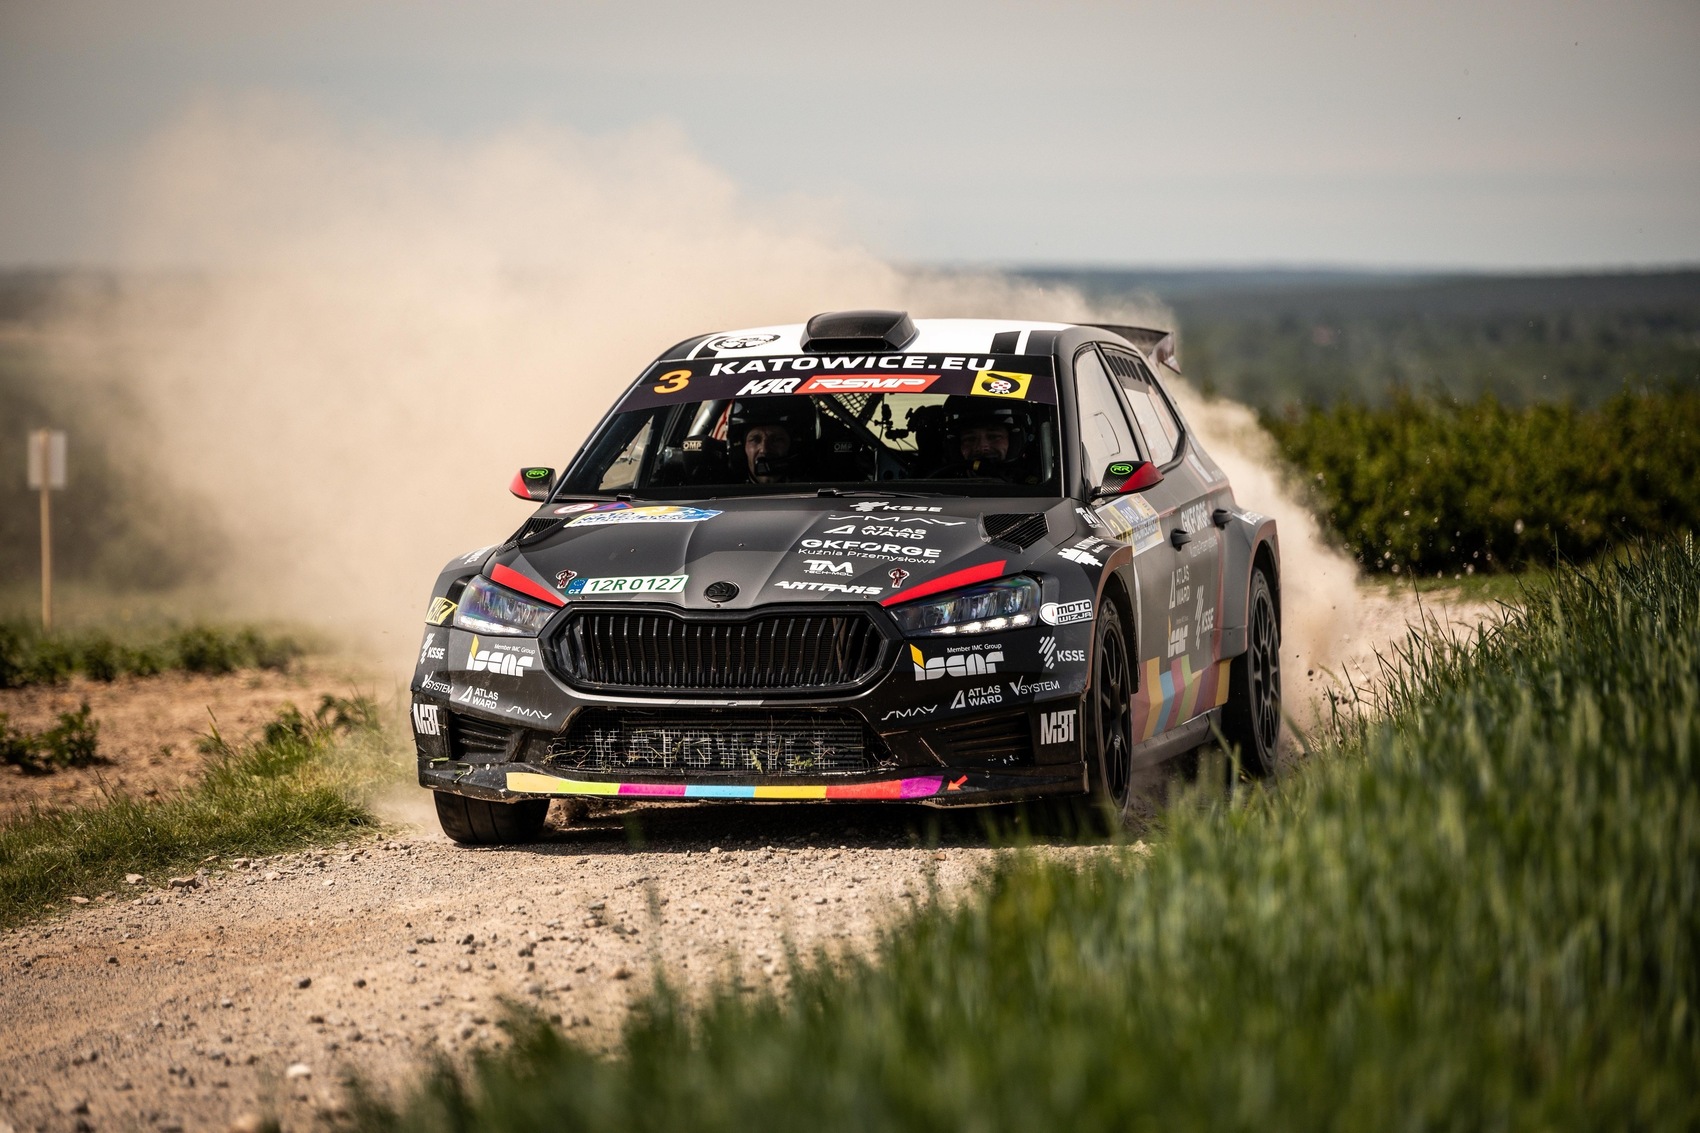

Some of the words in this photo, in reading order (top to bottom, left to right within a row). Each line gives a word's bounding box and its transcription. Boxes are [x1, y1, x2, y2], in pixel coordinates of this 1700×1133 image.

[709, 356, 995, 376] KATOWICE.EU
[653, 369, 692, 394] 3
[808, 378, 926, 391] RSMP
[683, 440, 702, 449] OMP
[861, 525, 927, 535] ATLAS
[861, 529, 925, 540] WARD
[801, 539, 942, 558] GKFORGE
[798, 548, 843, 556] Kuźnia
[847, 550, 936, 564] Przemysłowa
[1176, 564, 1190, 586] ATLAS
[590, 580, 623, 592] 12R
[629, 578, 684, 591] 0127
[1057, 601, 1092, 614] MOTO
[1201, 607, 1214, 634] KSSE
[427, 646, 445, 660] KSSE
[1057, 650, 1086, 662] KSSE
[474, 687, 499, 700] ATLAS
[967, 685, 1001, 697] ATLAS
[472, 697, 497, 710] WARD
[968, 694, 1003, 706] WARD
